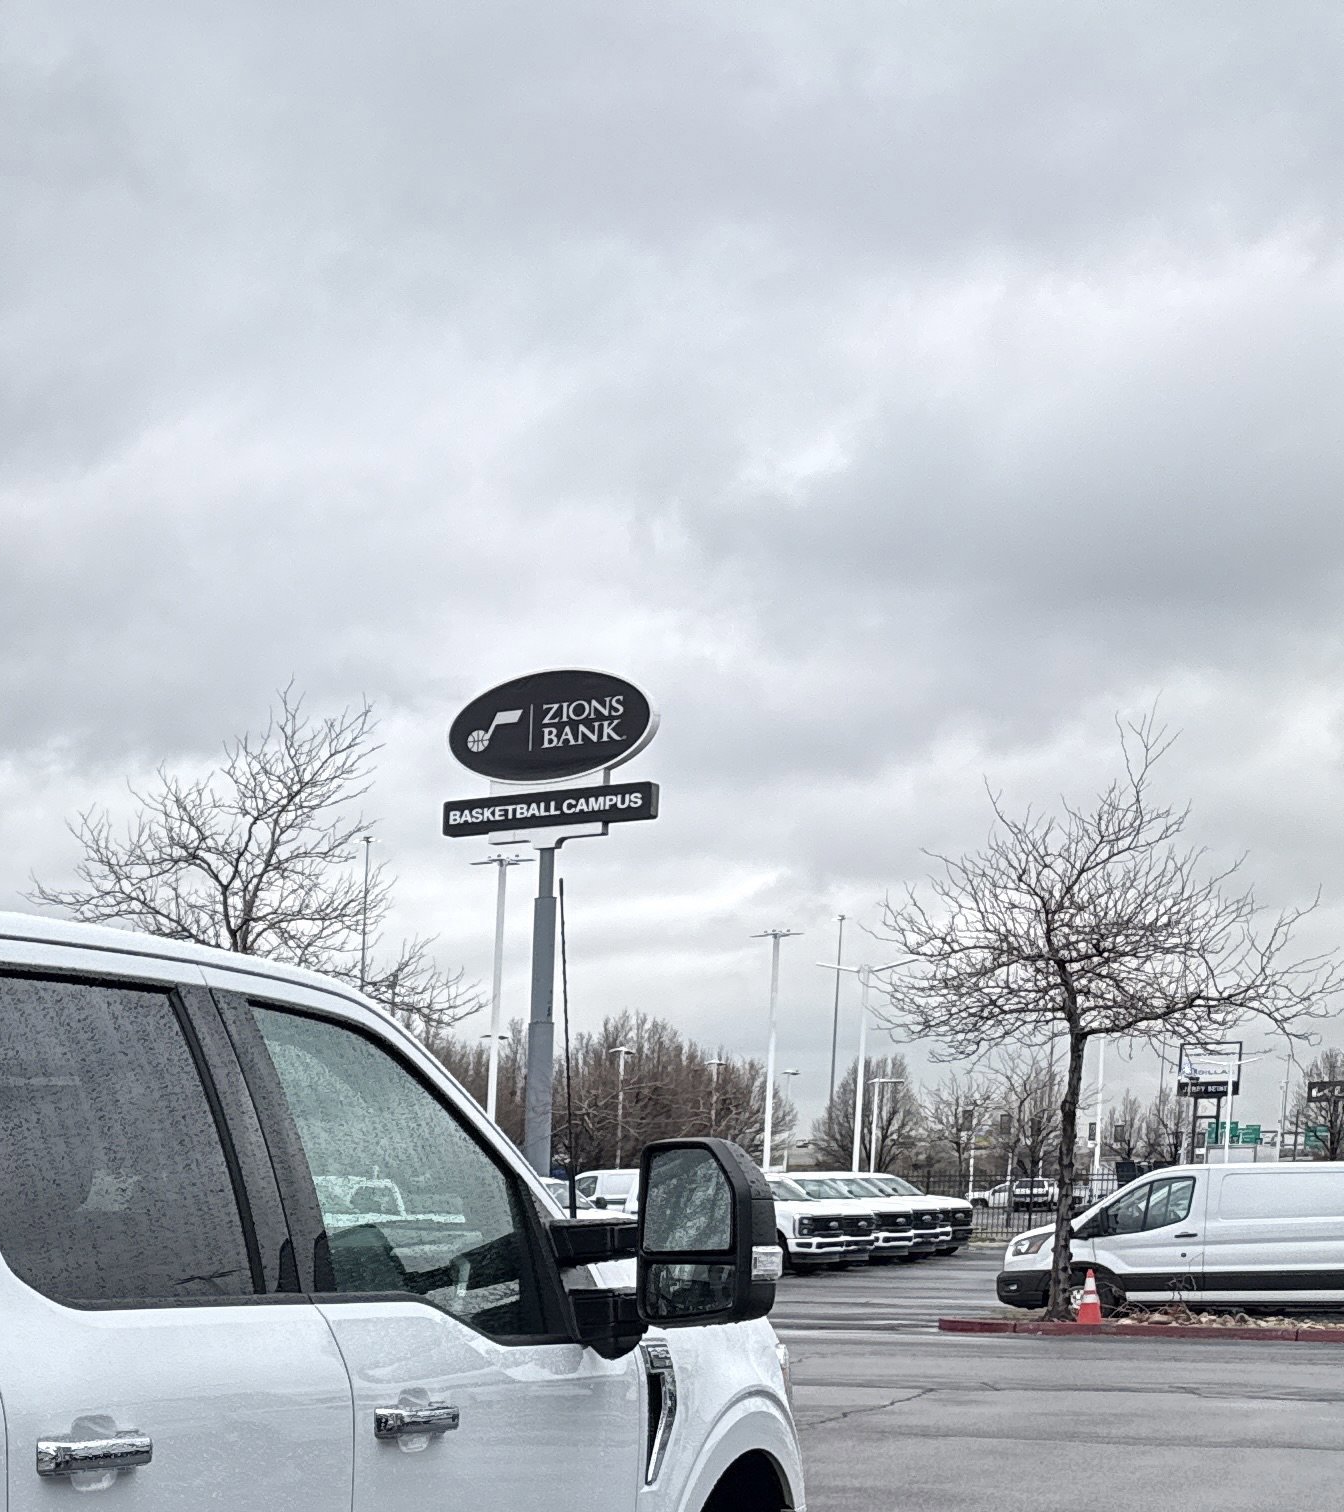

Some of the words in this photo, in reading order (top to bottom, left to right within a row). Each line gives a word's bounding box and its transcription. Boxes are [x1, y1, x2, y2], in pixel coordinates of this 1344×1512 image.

[541, 695, 624, 724] ZIONS
[540, 720, 624, 749] BANK
[448, 803, 561, 825] BASKETBALL
[562, 792, 643, 814] CAMPUS
